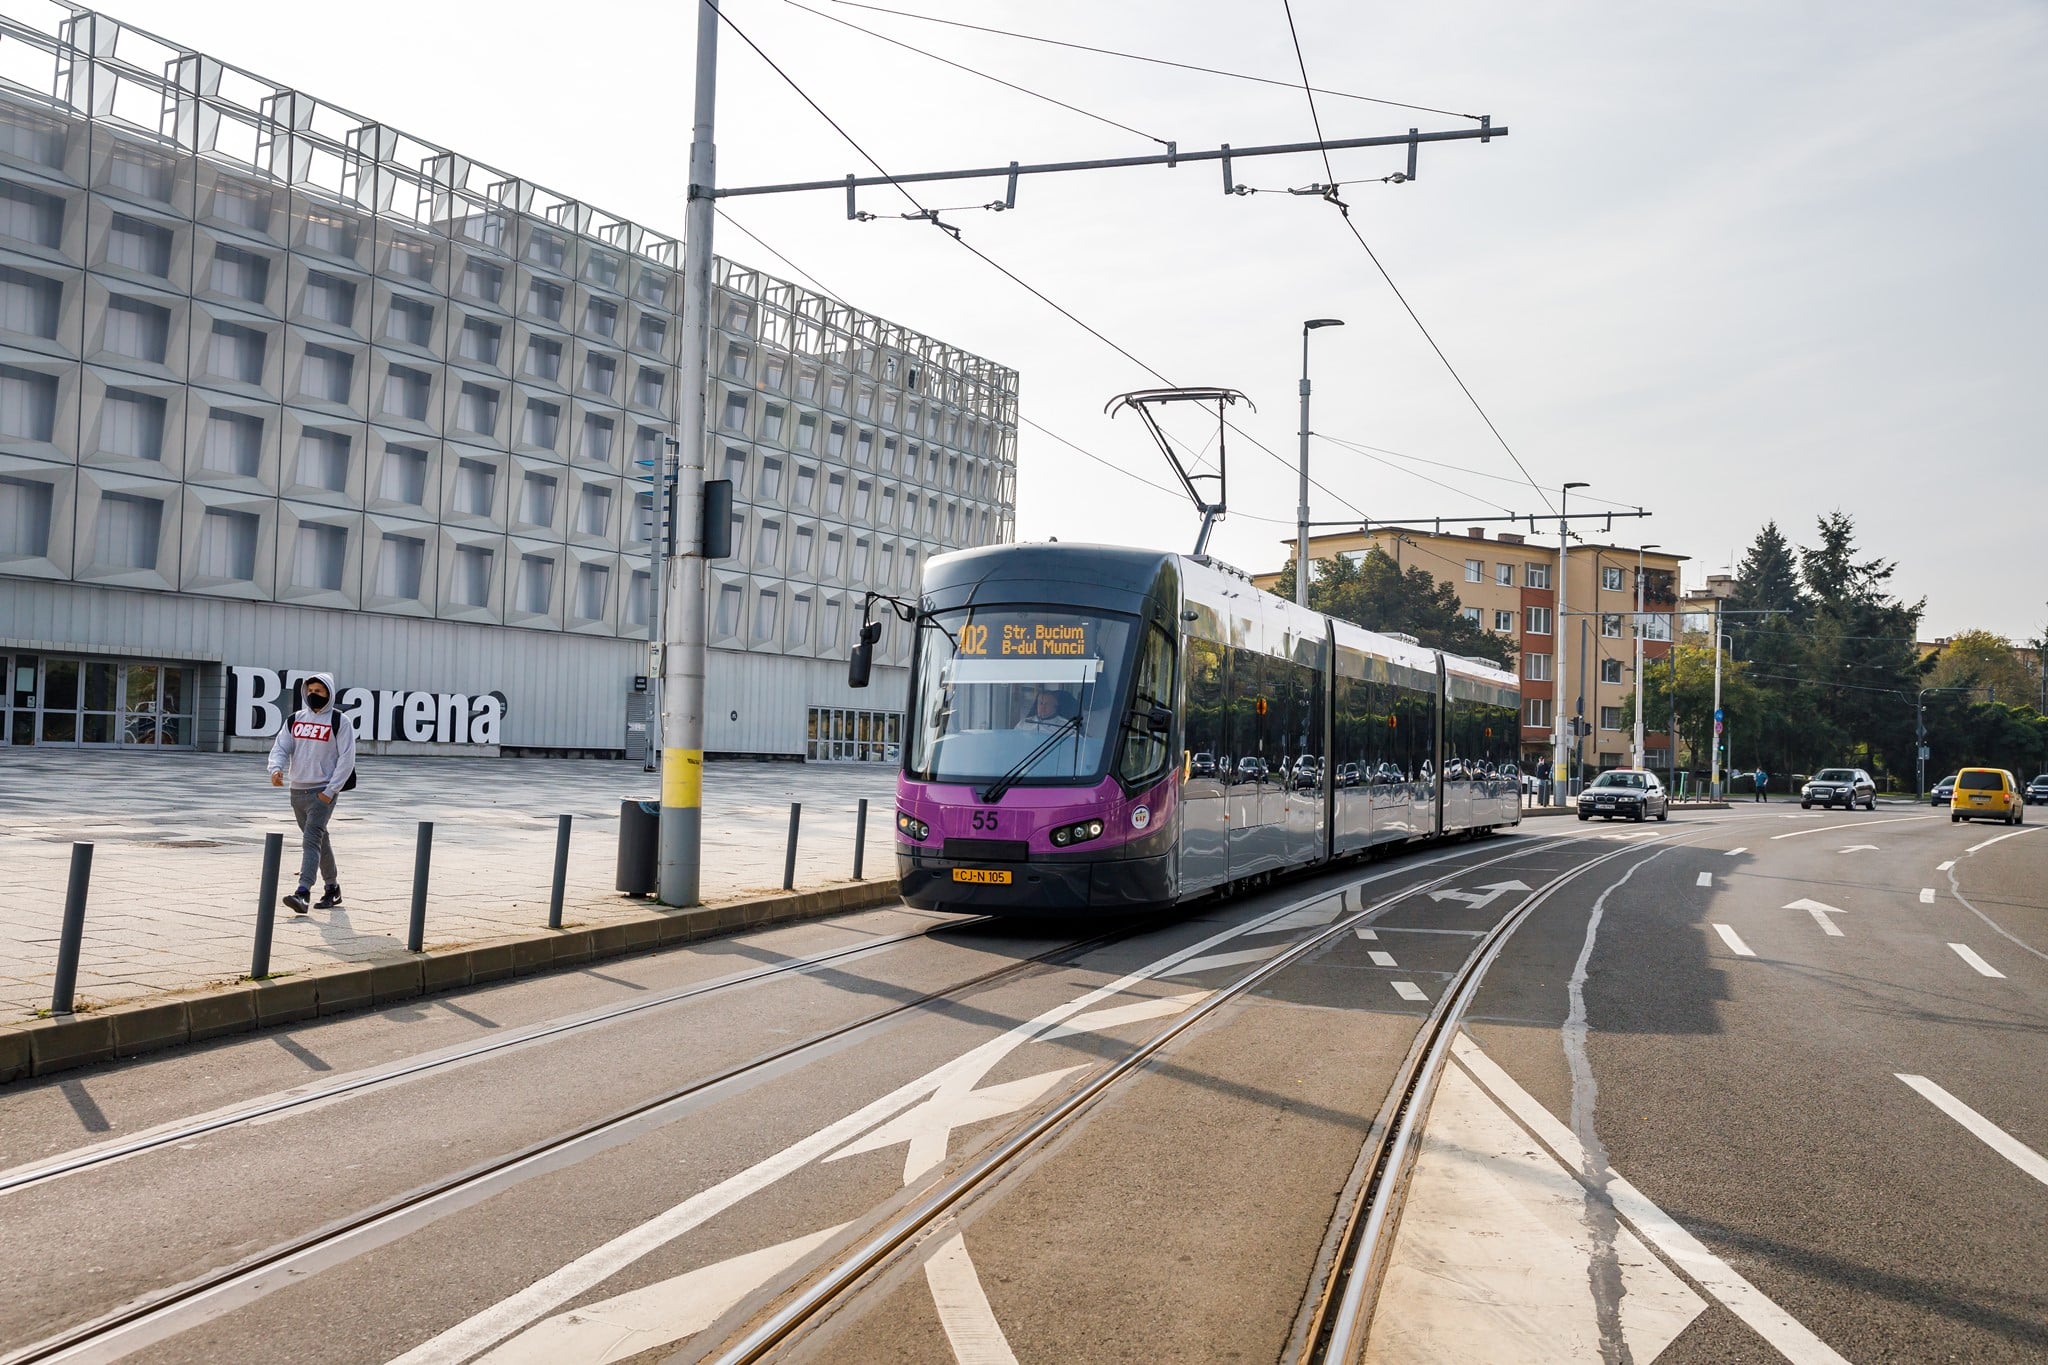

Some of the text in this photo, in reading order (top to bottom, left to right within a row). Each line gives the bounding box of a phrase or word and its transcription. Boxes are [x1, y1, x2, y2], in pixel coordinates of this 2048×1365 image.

[958, 624, 988, 655] 102
[1003, 624, 1084, 639] Str. Bucium
[1002, 640, 1085, 655] B-dul Muncii
[342, 687, 501, 744] arena
[293, 723, 330, 739] OBEY
[972, 810, 998, 830] 55
[960, 870, 1005, 882] CJ-N 105
